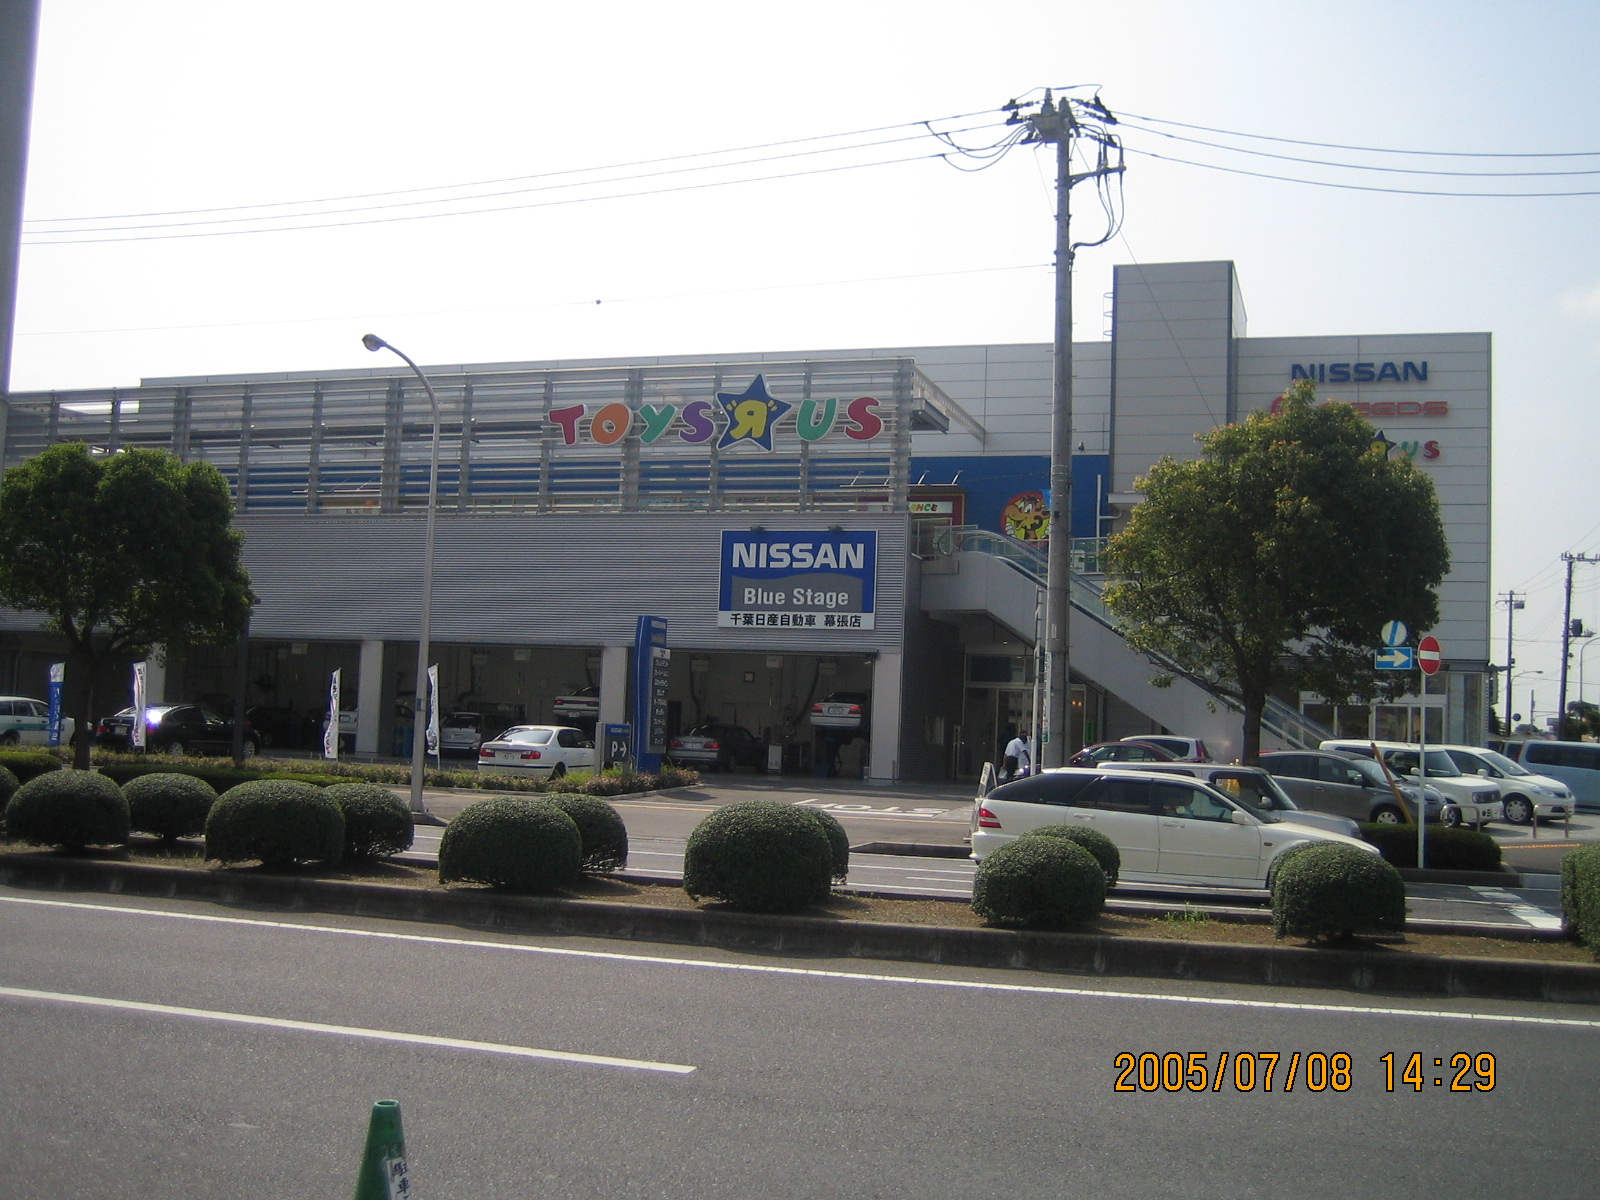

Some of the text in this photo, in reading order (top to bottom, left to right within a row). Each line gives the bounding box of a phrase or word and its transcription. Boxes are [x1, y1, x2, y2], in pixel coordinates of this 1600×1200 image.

[1292, 361, 1428, 382] NISSAN
[549, 400, 717, 445] TOYS
[796, 396, 885, 442] US
[732, 542, 865, 569] NISSAN
[743, 587, 849, 608] Blue Stage
[730, 613, 862, 628] 千葉日産自動車 幕張店
[392, 1161, 412, 1200] 駐車
